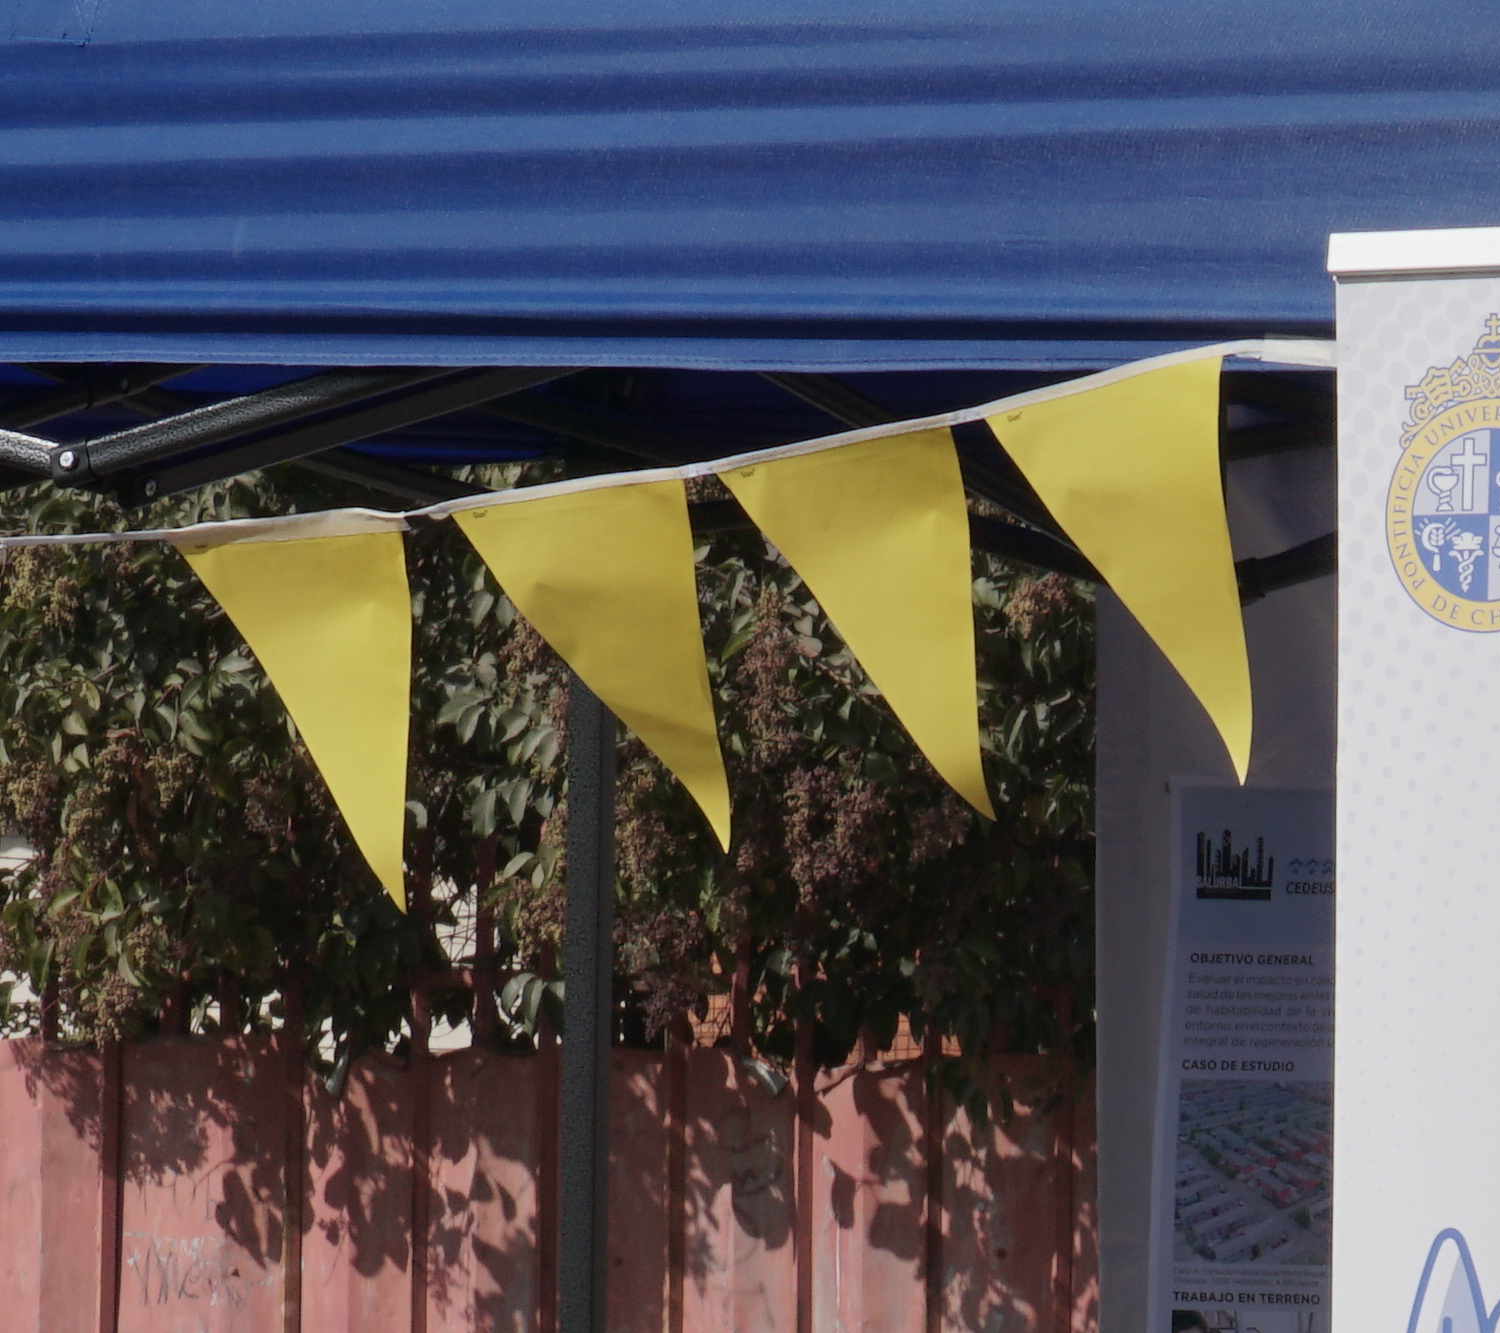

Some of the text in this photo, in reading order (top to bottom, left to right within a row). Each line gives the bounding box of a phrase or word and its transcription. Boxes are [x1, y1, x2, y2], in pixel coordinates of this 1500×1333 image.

[1391, 452, 1427, 592] PONTIFICIA
[1431, 593, 1460, 621] DE
[1190, 952, 1315, 966] OBJETIVO GENERAL
[1182, 1059, 1294, 1072] CASO DE ESTUDIO
[1173, 1291, 1321, 1305] TRABAJO EN TERRENO
